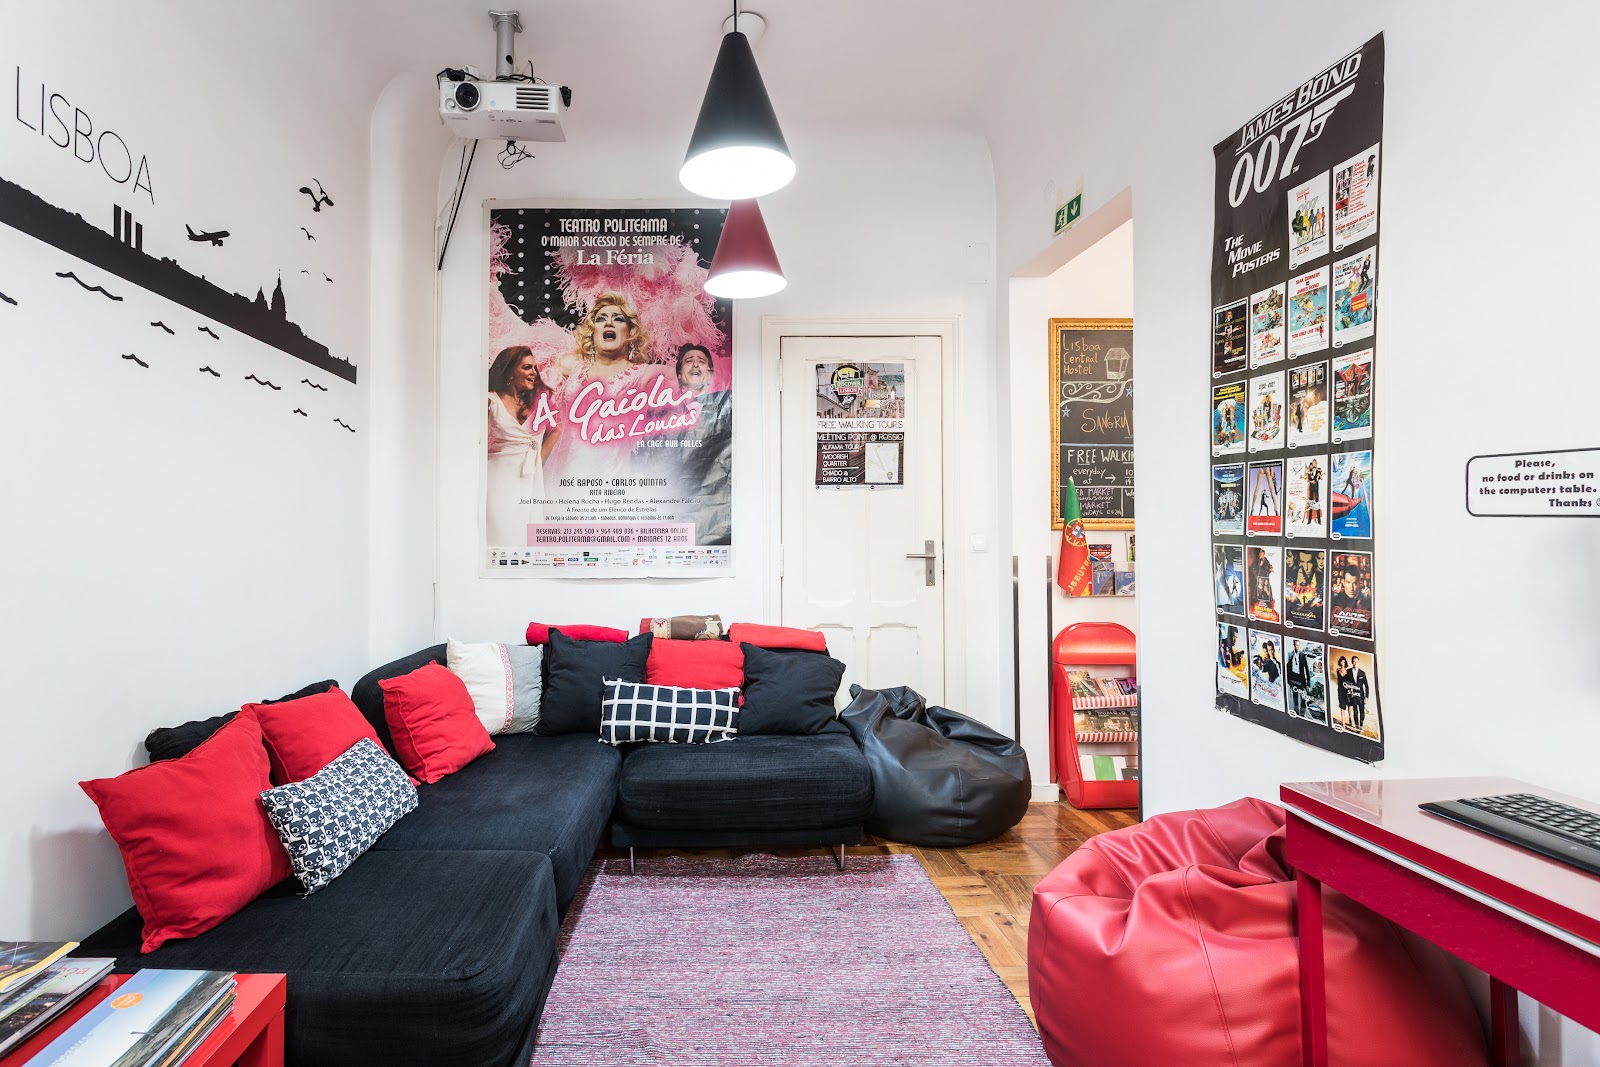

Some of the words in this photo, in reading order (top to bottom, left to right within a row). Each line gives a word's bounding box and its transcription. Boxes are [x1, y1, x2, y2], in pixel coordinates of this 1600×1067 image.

[1240, 96, 1295, 150] JAMES
[1295, 51, 1363, 111] BOND
[16, 65, 155, 206] LISBOA
[1228, 97, 1330, 208] 007
[559, 218, 600, 232] TEATRO
[604, 218, 668, 232] POLITEAMA
[541, 236, 548, 247] O
[550, 235, 580, 247] MAIOR
[582, 235, 617, 247] SUCESSO
[619, 235, 630, 247] DE
[632, 235, 668, 246] SEMPRE
[669, 235, 682, 246] DE
[1224, 234, 1244, 252] THE
[576, 250, 600, 266] La
[605, 249, 654, 266] Féria
[1227, 240, 1263, 265] MOVIE
[1231, 248, 1281, 279] POSTERS
[1062, 333, 1101, 352] Lisboa
[1063, 352, 1098, 364] Central
[1063, 364, 1092, 375] Hostel
[532, 392, 560, 432] A
[590, 423, 626, 445] das
[628, 409, 697, 437] Loucas
[816, 420, 836, 429] FREE
[839, 420, 875, 429] WALKING
[877, 420, 904, 429] TOURS
[1081, 408, 1131, 436] SANGRIA
[636, 440, 644, 448] LA
[647, 440, 664, 448] CAGE
[665, 440, 678, 448] AUX
[680, 440, 702, 448] FOLLES
[1067, 449, 1097, 464] FREE
[822, 460, 848, 468] QUARTER
[1514, 460, 1556, 468] Please,
[1072, 467, 1106, 478] everyday
[1497, 473, 1520, 482] food
[1538, 471, 1575, 480] drinks
[559, 476, 575, 487] JOSÉ
[577, 478, 603, 487] RAPOSO
[611, 478, 636, 487] CARLOS
[638, 478, 668, 488] QUINTAS
[1088, 488, 1115, 496] MARKET
[1499, 486, 1556, 496] computers
[1560, 484, 1598, 494] table.
[604, 498, 621, 506] Hugo
[1548, 498, 1592, 508] Thanks
